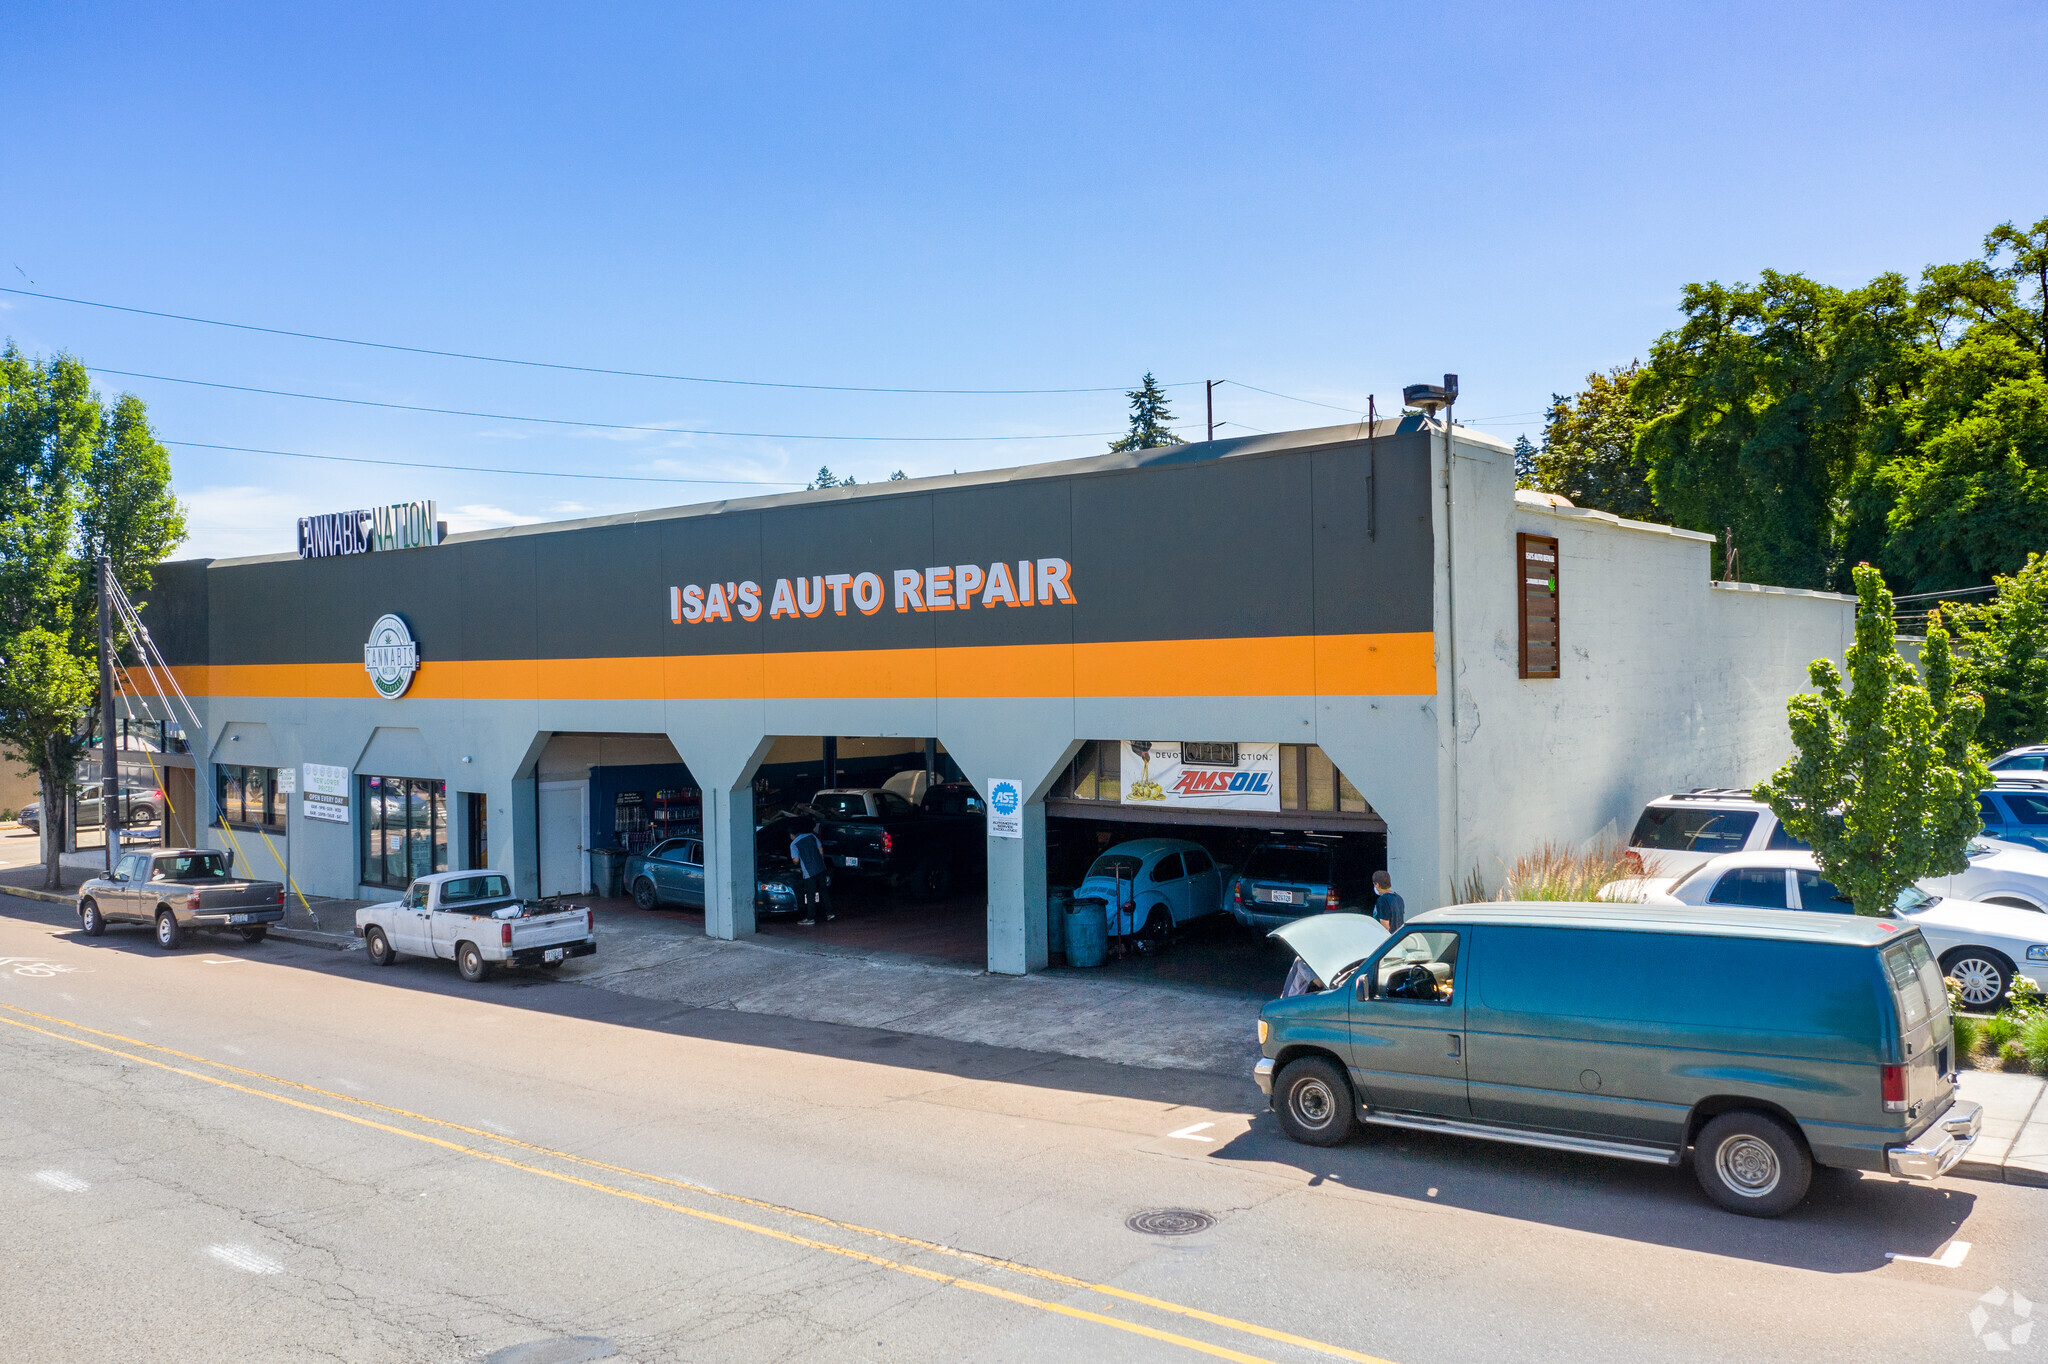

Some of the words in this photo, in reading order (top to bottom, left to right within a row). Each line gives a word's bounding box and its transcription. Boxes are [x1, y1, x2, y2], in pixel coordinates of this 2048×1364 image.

[297, 511, 369, 559] CANNABIS
[372, 500, 434, 552] NATION
[669, 580, 762, 624] ISA'S
[769, 571, 885, 619] AUTO
[893, 556, 1078, 613] REPAIR
[366, 647, 414, 667] CANNABIS
[1155, 751, 1181, 759] DEVO
[1172, 770, 1270, 795] AMSOIL
[321, 795, 334, 803] EVERY
[335, 796, 344, 804] DAY
[995, 791, 1014, 804] ASE
